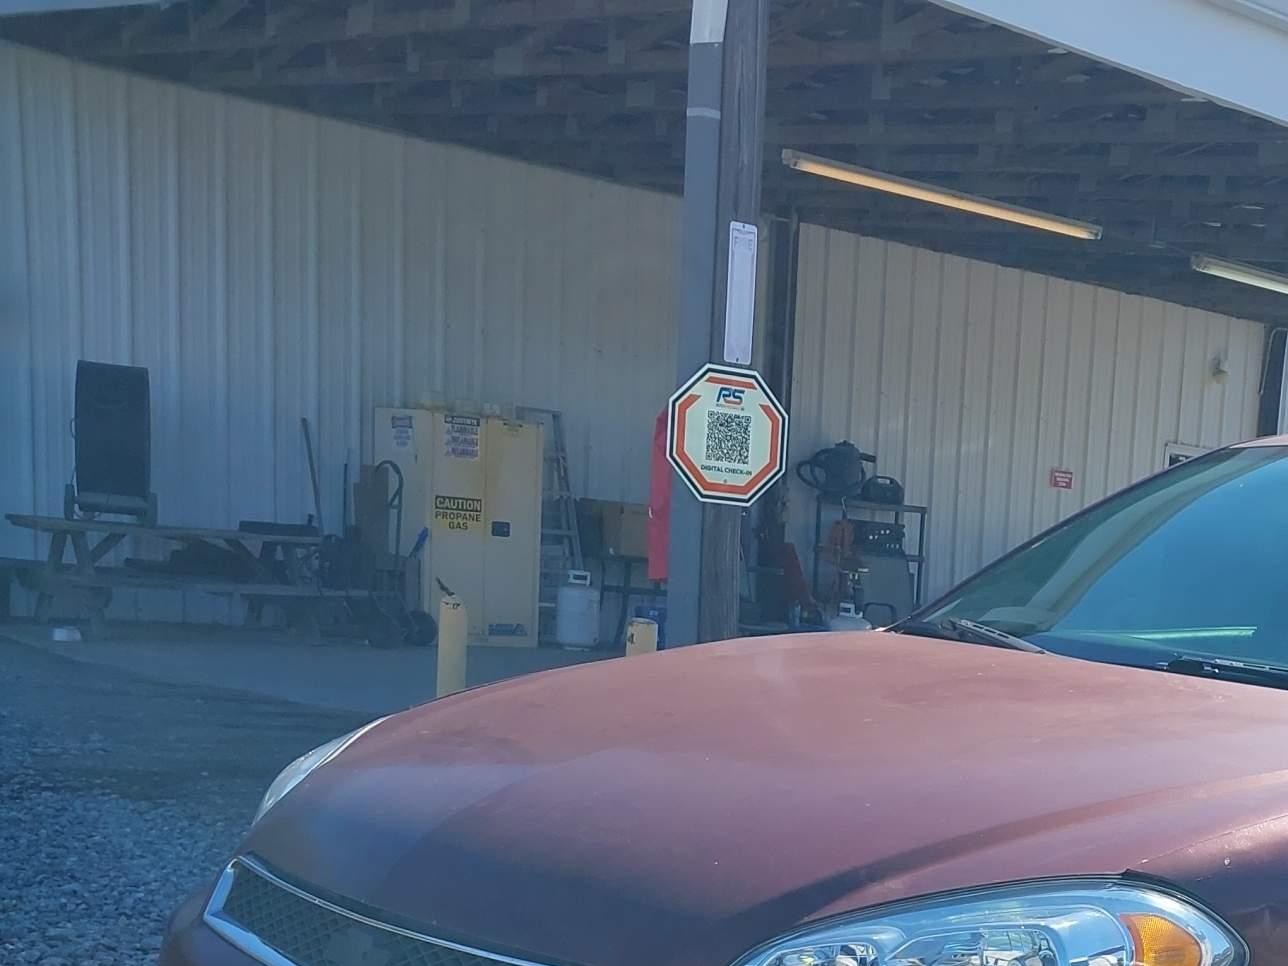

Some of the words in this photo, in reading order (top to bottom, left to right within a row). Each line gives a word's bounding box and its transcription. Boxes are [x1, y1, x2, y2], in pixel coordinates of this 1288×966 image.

[700, 464, 724, 473] DIGITAL
[724, 467, 752, 476] CHECK-IN
[436, 497, 481, 511] CAUTION
[435, 511, 481, 522] PROPANE
[448, 521, 468, 530] GAS
